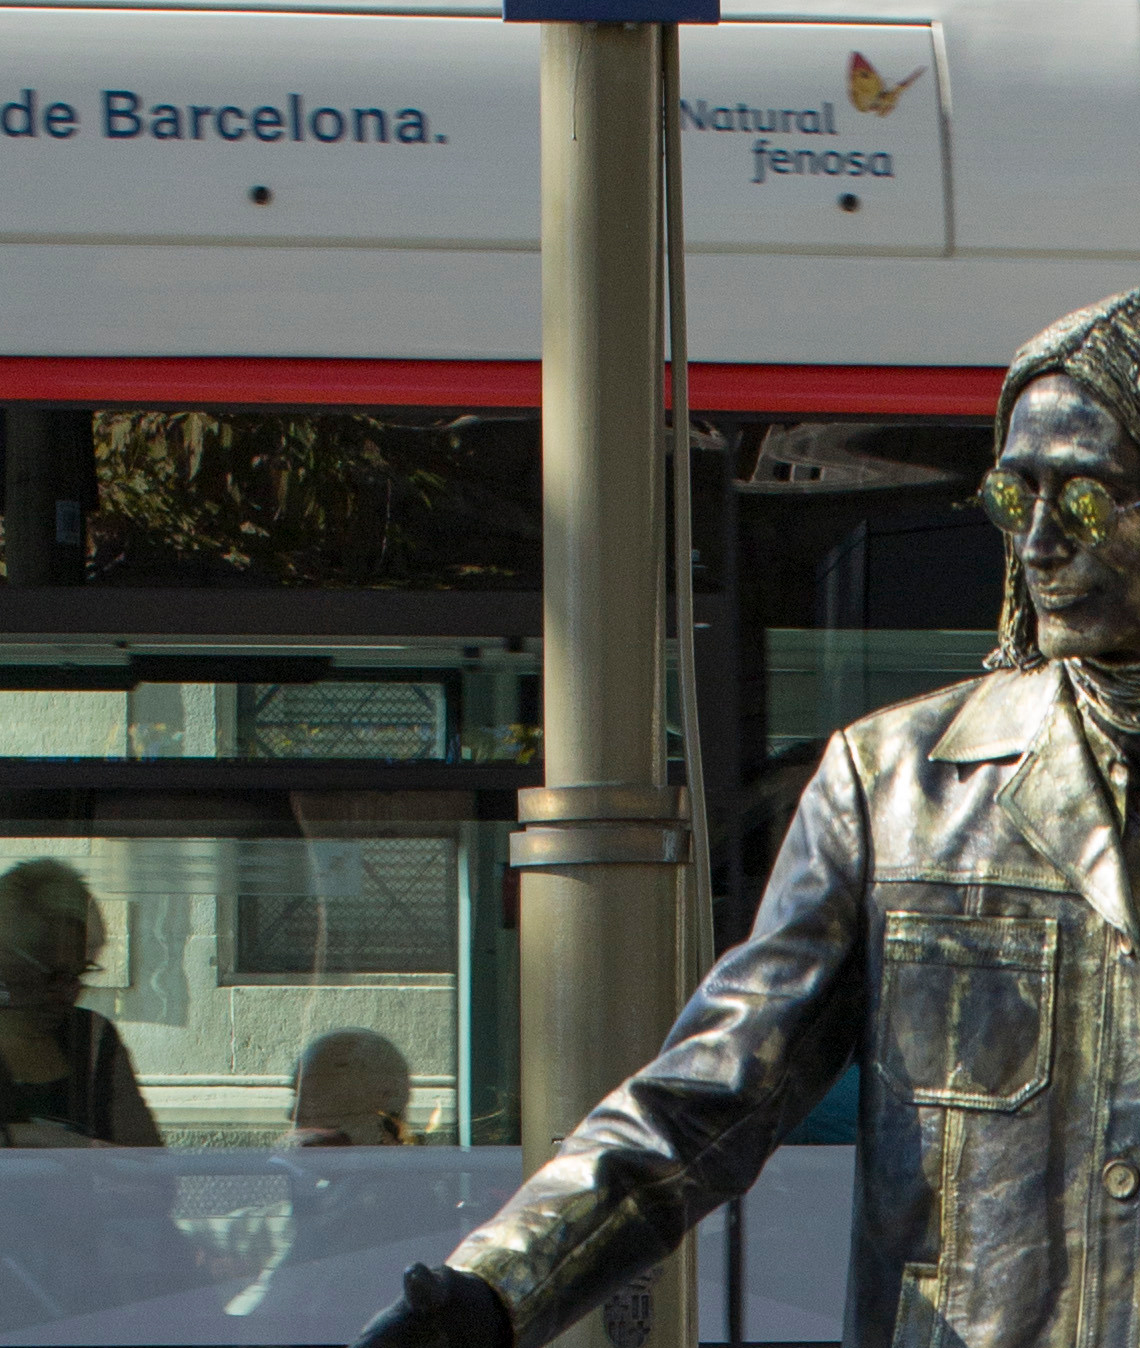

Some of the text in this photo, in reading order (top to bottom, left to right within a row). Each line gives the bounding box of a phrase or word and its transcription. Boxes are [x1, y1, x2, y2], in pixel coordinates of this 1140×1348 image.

[0, 88, 449, 144] de Barcelona.
[679, 98, 839, 136] Natural
[751, 138, 895, 184] fenosa
